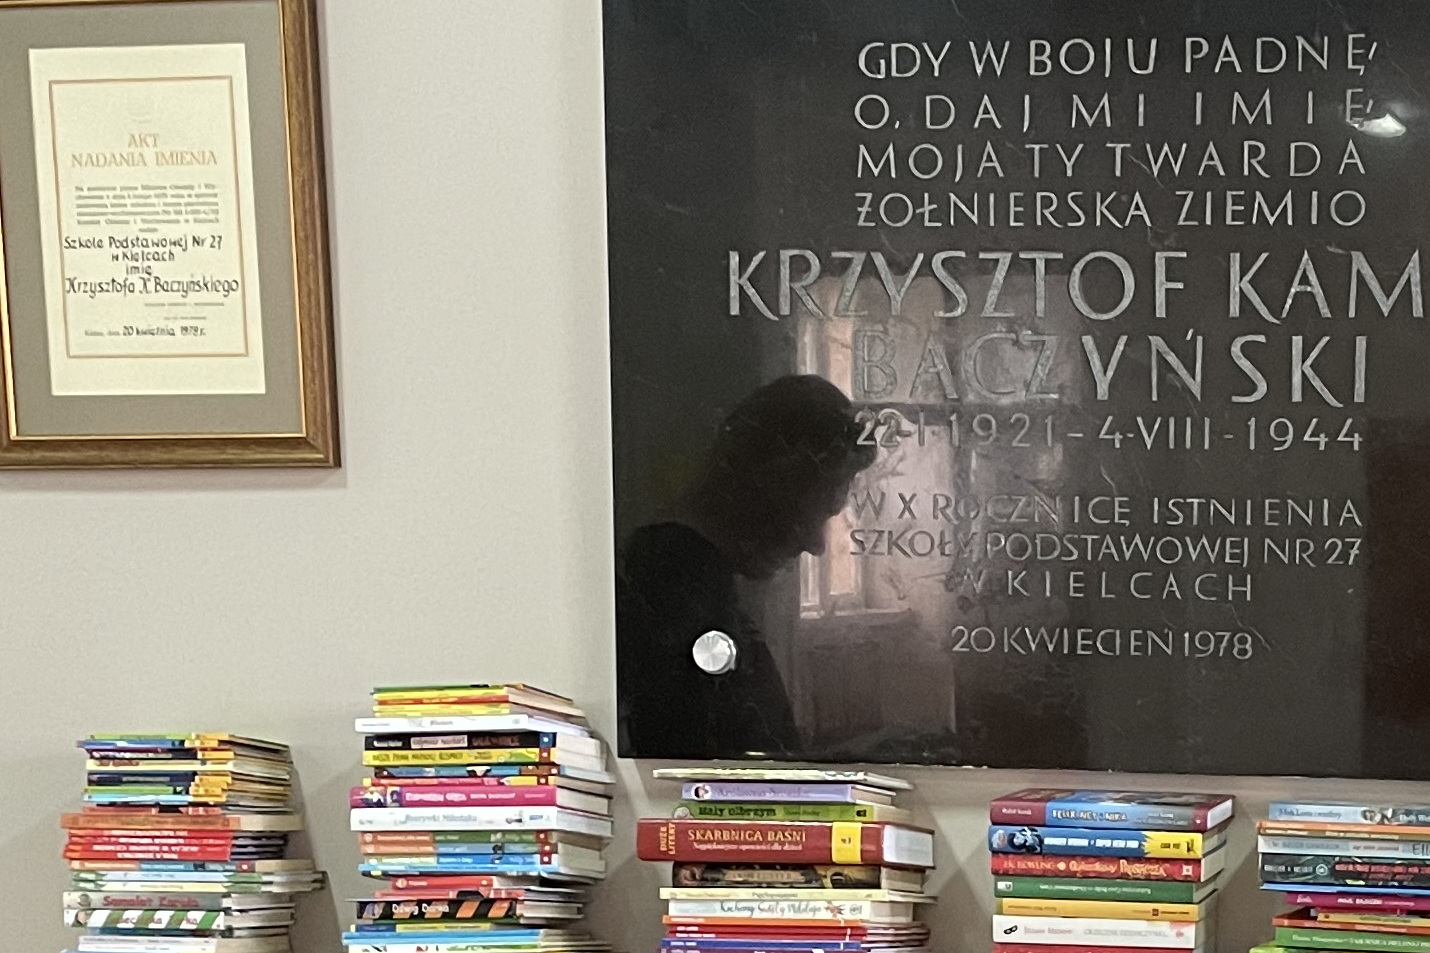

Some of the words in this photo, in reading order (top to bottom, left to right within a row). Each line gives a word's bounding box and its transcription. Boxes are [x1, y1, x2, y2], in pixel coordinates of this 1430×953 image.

[858, 41, 949, 78] GDY
[969, 41, 1009, 77] W
[1029, 38, 1157, 77] BOJU
[926, 93, 1030, 132] DAJ
[1072, 93, 1144, 127] MI
[72, 152, 147, 168] NADANIA
[155, 150, 218, 166] IMIENIA
[128, 133, 160, 148] AKT
[857, 142, 1004, 182] MOJA
[1025, 143, 1083, 177] TY
[1107, 140, 1365, 177] TWARDA
[856, 191, 1151, 228] ŻOŁNIERSKA
[1176, 191, 1365, 226] ZIEMIO
[729, 250, 1188, 321] KRZYSZTOF
[854, 328, 1366, 407] BACZYŃSKI
[852, 493, 883, 519] W
[899, 493, 916, 519] X
[933, 494, 1130, 528] ROCZNICĘ
[1154, 498, 1361, 526] ISTNIENIA
[850, 529, 979, 559] SZKOŁY
[987, 534, 1248, 567] PODSTAWOWEJ
[1264, 537, 1314, 565] NR
[1325, 538, 1361, 565] 27
[1008, 571, 1251, 601] KIELCACH
[951, 626, 995, 652] 20
[1184, 630, 1252, 659] 1978
